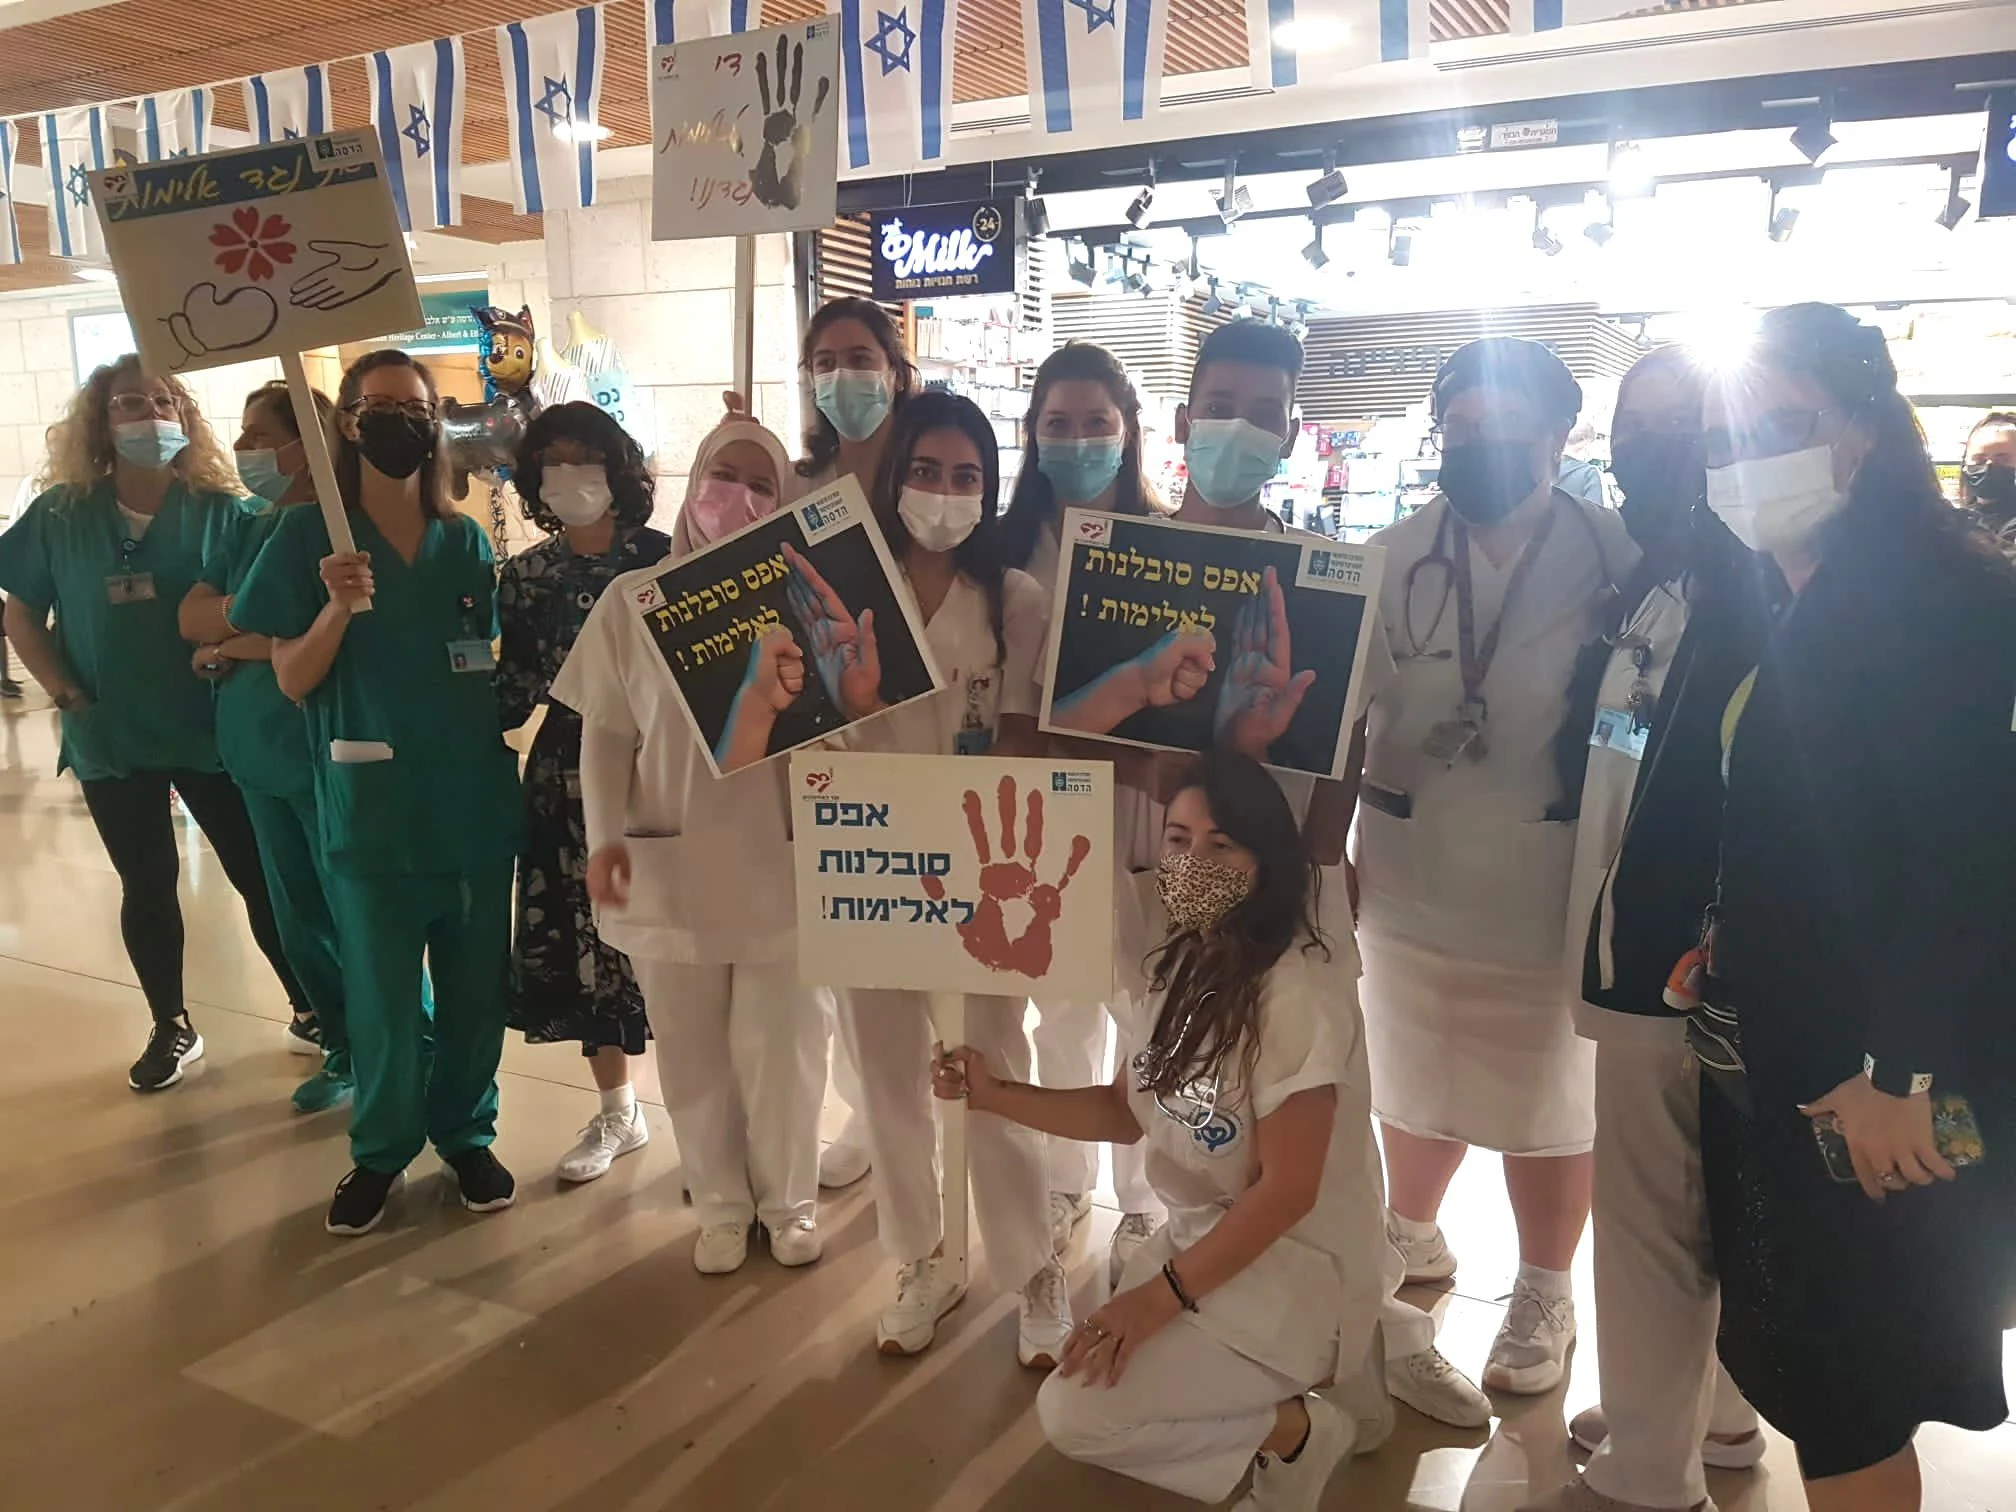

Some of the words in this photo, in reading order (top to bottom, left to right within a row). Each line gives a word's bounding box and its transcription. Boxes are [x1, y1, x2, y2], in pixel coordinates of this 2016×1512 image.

[713, 52, 742, 78] די
[240, 155, 303, 195] נגד
[979, 218, 995, 232] 24
[415, 331, 437, 341] Center
[442, 329, 462, 340] Albert
[822, 505, 849, 526] הדסה
[741, 552, 792, 592] אפס
[1084, 545, 1193, 587] סובלנות
[1327, 568, 1361, 583] הדסה
[1203, 565, 1261, 597] אפס
[655, 578, 741, 633] סובלנות
[1097, 594, 1217, 635] לאלימות
[690, 606, 781, 666] לאלימות
[1067, 783, 1092, 793] הדסה
[815, 802, 890, 828] אפס
[817, 847, 951, 877] סובלנות
[820, 895, 975, 924] לאלימות!
